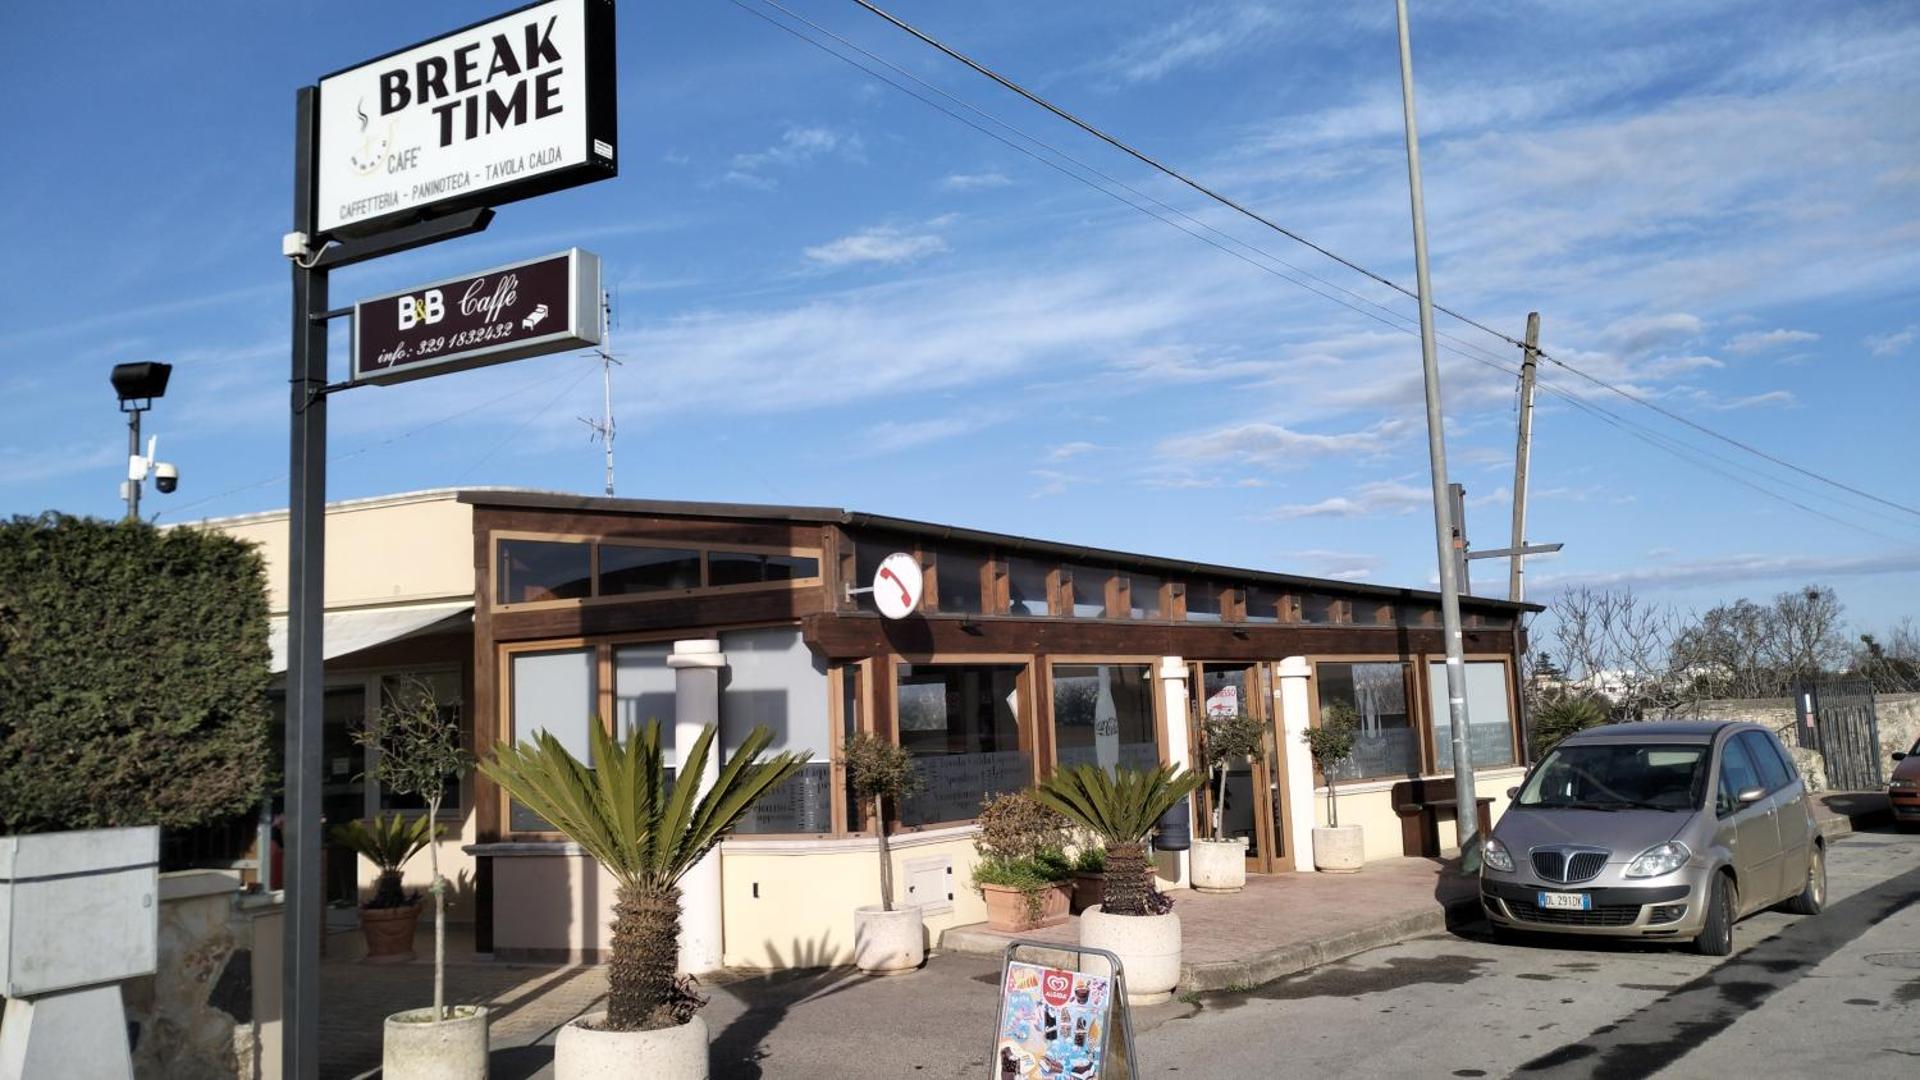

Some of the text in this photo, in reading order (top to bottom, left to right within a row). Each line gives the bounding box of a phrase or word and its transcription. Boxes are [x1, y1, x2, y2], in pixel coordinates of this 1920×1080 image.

[380, 15, 562, 116] BREAK
[432, 67, 563, 147] TIME
[340, 190, 399, 220] CAFFETTERIA
[412, 171, 471, 200] PANINOTECA
[485, 157, 525, 181] TAVOLA
[529, 145, 562, 171] CALDA
[398, 288, 445, 331] B&B
[416, 336, 445, 356] 329
[448, 321, 513, 350] 1832432
[1546, 895, 1555, 905] DL
